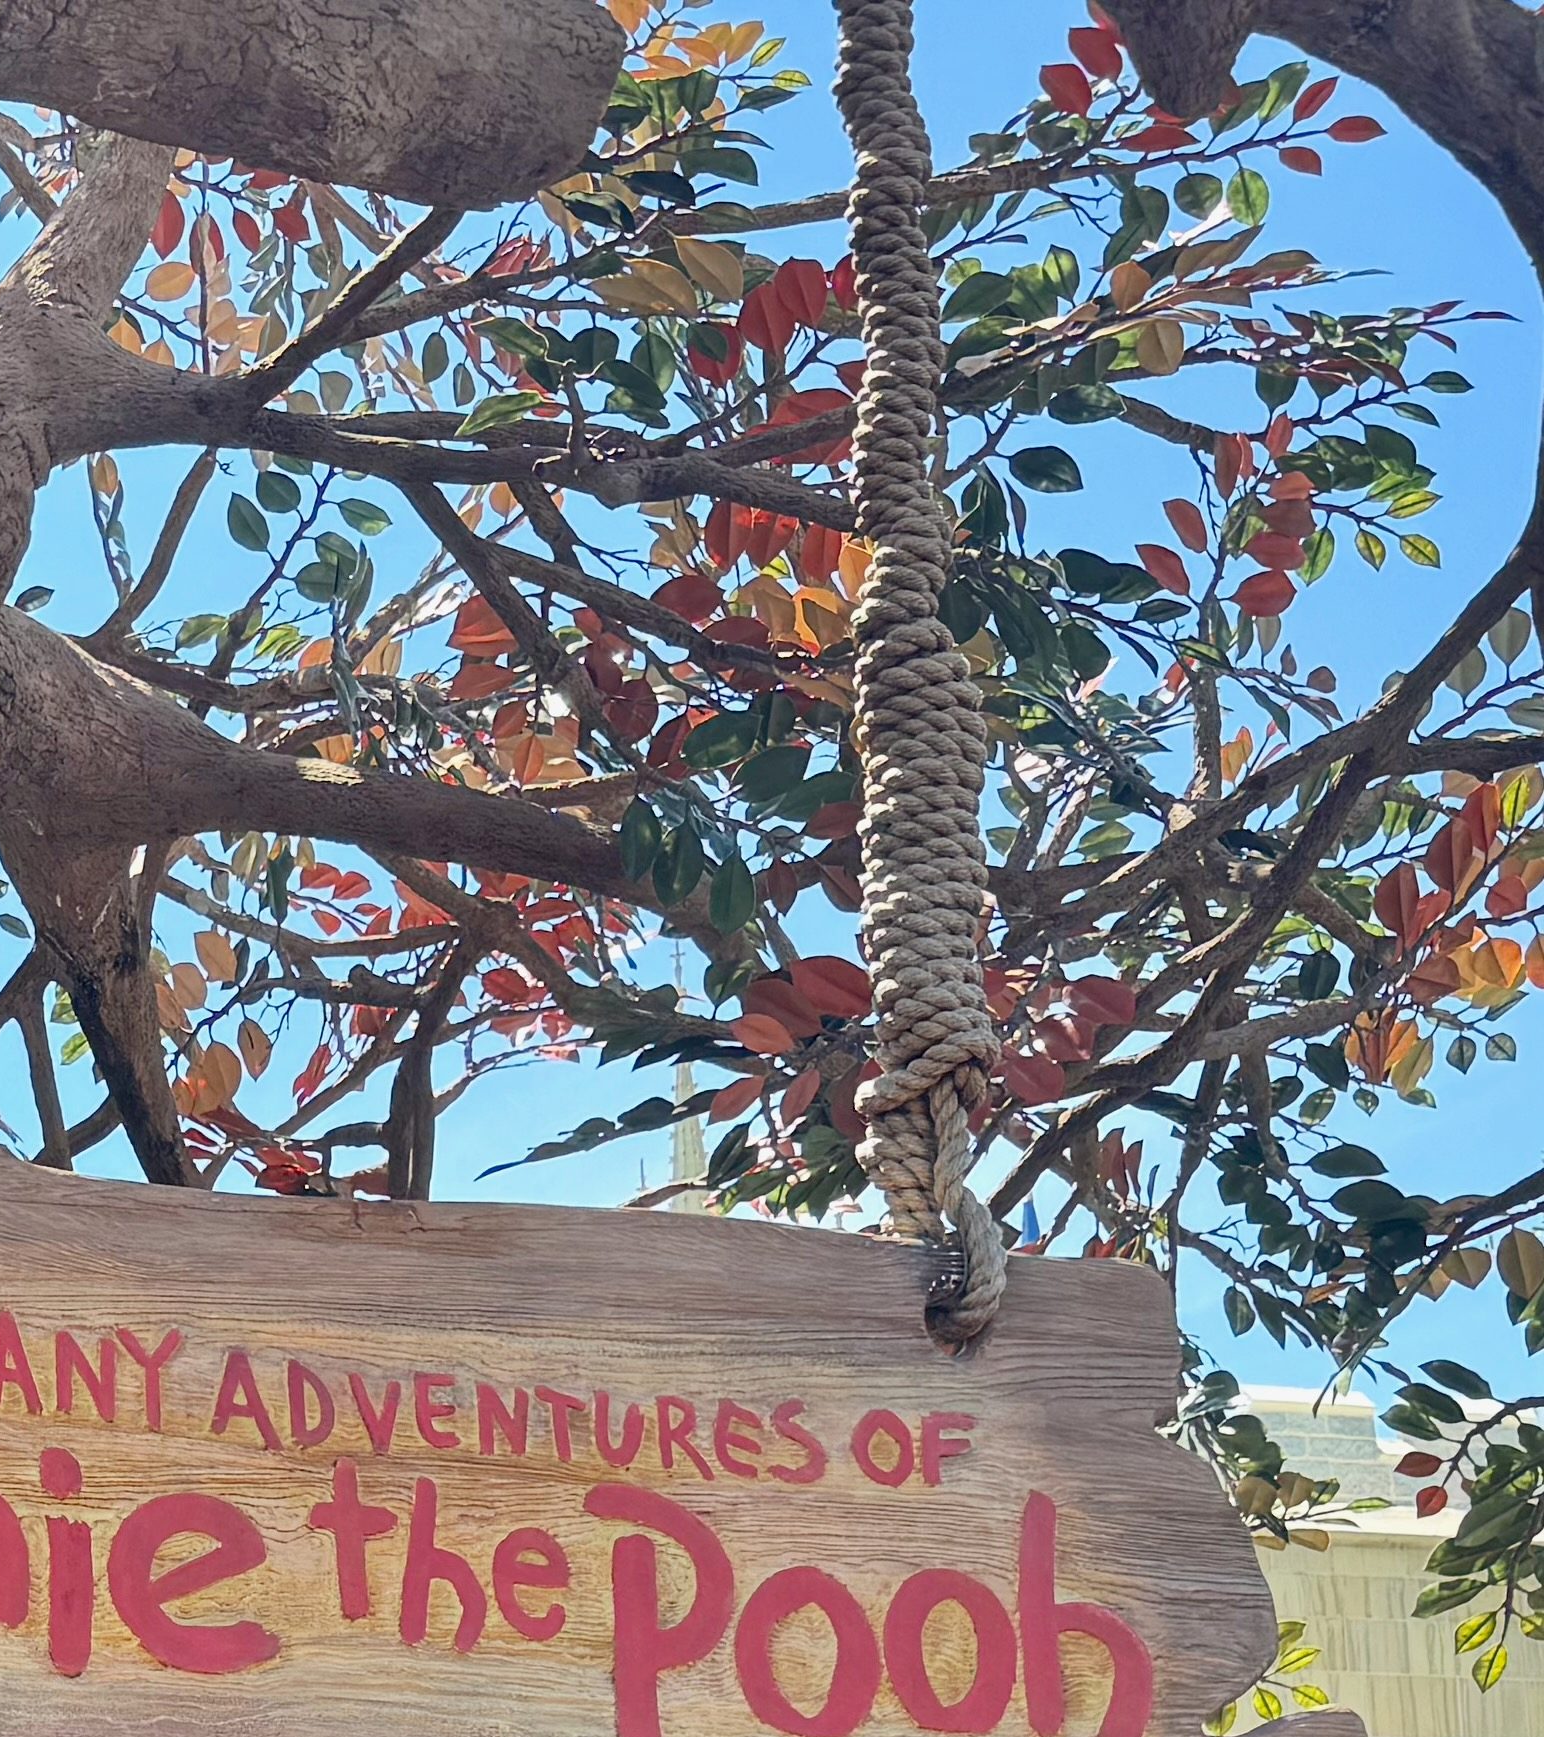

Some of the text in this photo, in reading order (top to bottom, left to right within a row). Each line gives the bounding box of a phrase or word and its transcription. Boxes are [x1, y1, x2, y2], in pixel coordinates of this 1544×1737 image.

[211, 1350, 830, 1485] ADVENTURES
[851, 1408, 977, 1488] OF
[311, 1455, 572, 1654] the
